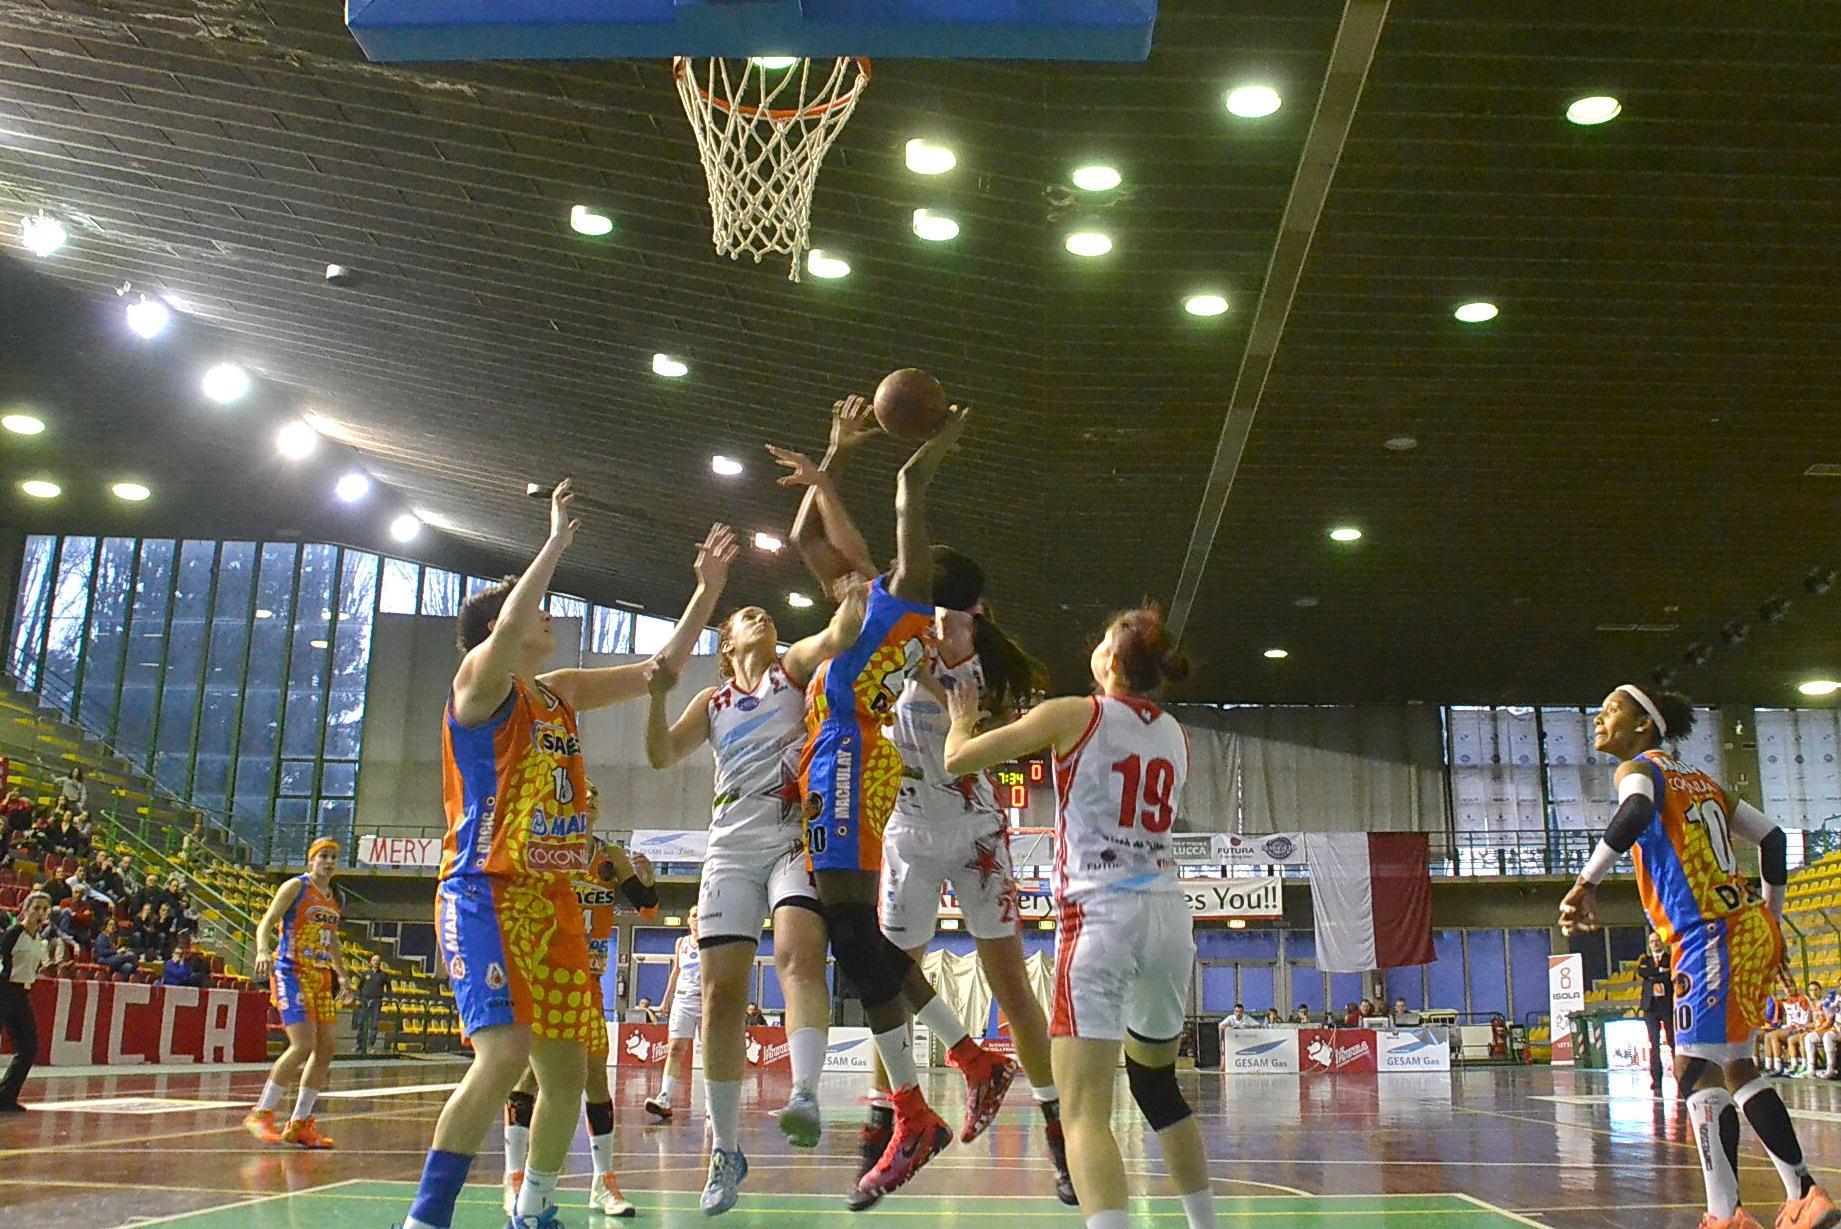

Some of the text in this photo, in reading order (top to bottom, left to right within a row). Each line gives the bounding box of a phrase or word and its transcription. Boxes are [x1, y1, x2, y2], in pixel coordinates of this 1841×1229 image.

[1031, 764, 1042, 780] 0
[835, 749, 852, 819] MACAULAY
[1112, 753, 1174, 832] 19
[369, 838, 432, 864] MERY
[1173, 846, 1206, 855] LUCCA
[1213, 886, 1277, 910] You!!
[1553, 992, 1580, 1000] ISOLA
[0, 979, 238, 1066] UCCA
[851, 1056, 867, 1066] Gas
[1235, 1059, 1287, 1067] GESAM Gas
[1387, 1057, 1439, 1066] GESAM Gas
